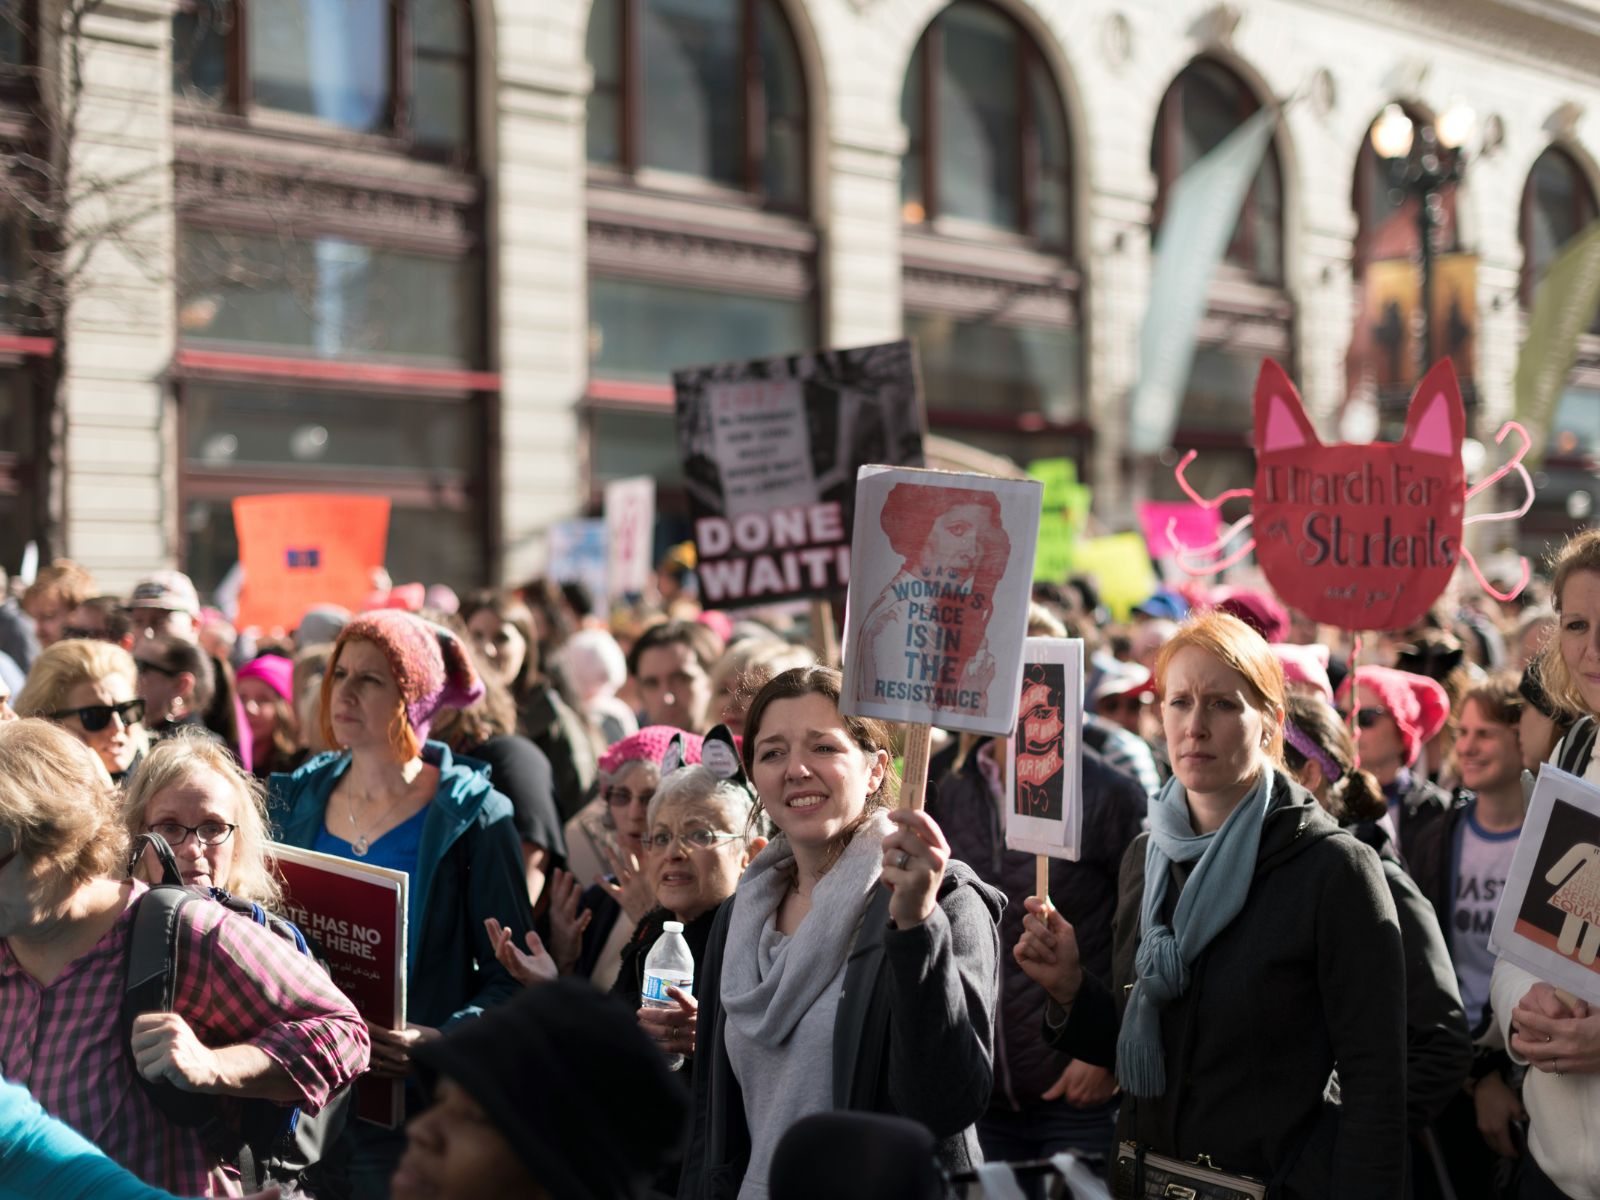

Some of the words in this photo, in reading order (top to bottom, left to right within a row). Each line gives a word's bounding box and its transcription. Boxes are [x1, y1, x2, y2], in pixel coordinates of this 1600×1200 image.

[1265, 464, 1282, 503] I
[696, 502, 845, 557] DONE
[1297, 511, 1457, 569] Students
[935, 566, 943, 577] A
[891, 580, 985, 609] WOMAN'S
[908, 601, 964, 625] PLACE
[905, 623, 927, 648] IS
[935, 627, 961, 653] IN
[904, 651, 959, 684] THE
[874, 679, 981, 709] RESISTANCE
[276, 904, 309, 926] ATE
[312, 912, 348, 936] HAS
[352, 923, 381, 945] NO
[1552, 895, 1600, 928] EQUAL
[326, 932, 377, 961] HERE.
